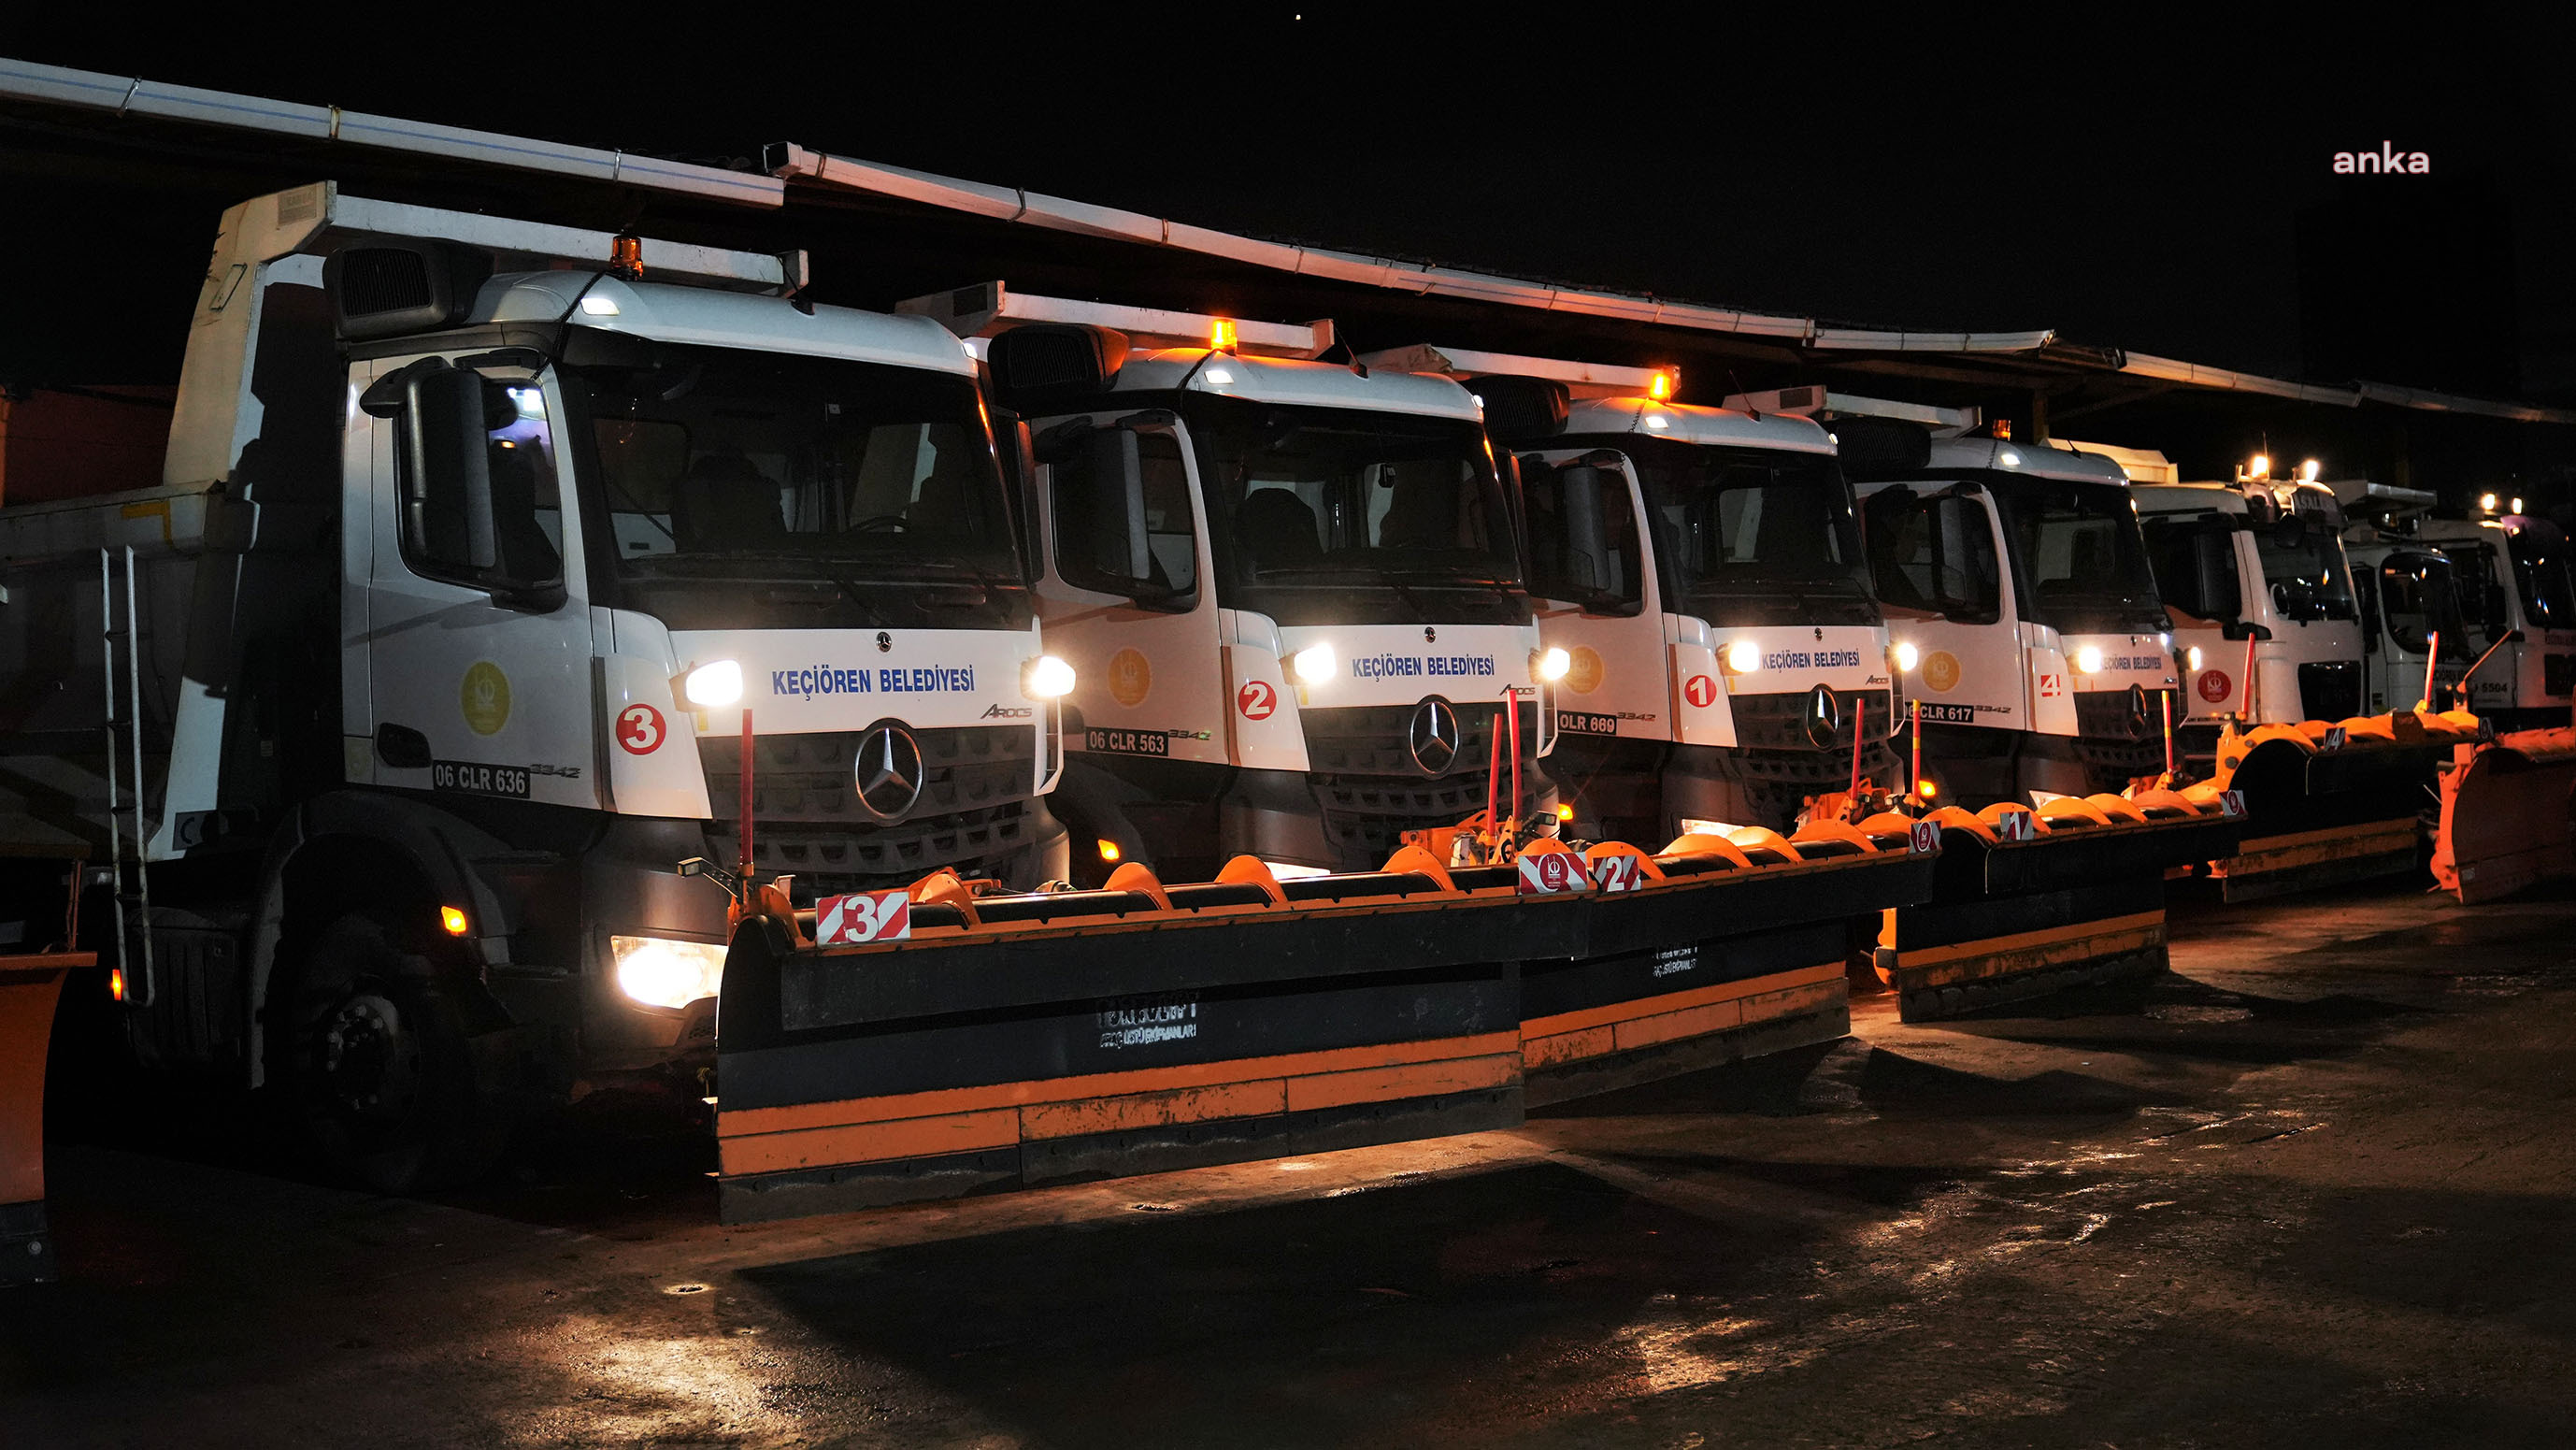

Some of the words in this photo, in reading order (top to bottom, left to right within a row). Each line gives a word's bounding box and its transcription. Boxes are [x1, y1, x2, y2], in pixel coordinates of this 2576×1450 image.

[1352, 653, 1423, 682] KEÇİÖREN
[1427, 653, 1496, 677] BELEDİYESİ
[1762, 649, 1811, 673] KEÇİÖREN
[1814, 648, 1860, 668] BELEDİYESİ
[772, 665, 872, 701] KEÇİÖREN
[880, 664, 976, 693] BELEDİYESİ
[1689, 677, 1708, 706] 1
[2041, 675, 2061, 697] 4
[1243, 683, 1270, 716] 2
[1920, 706, 1944, 720] CLR
[1948, 707, 1972, 721] 617
[623, 708, 658, 750] 3
[1590, 716, 1615, 734] 669
[1089, 730, 1106, 749] 06
[1109, 732, 1137, 752] CLR
[1139, 734, 1166, 754] 563
[435, 764, 454, 788] 06
[458, 765, 492, 792] CLR
[494, 769, 526, 795] 636
[1606, 856, 1625, 893] 2
[844, 896, 880, 942] 3
